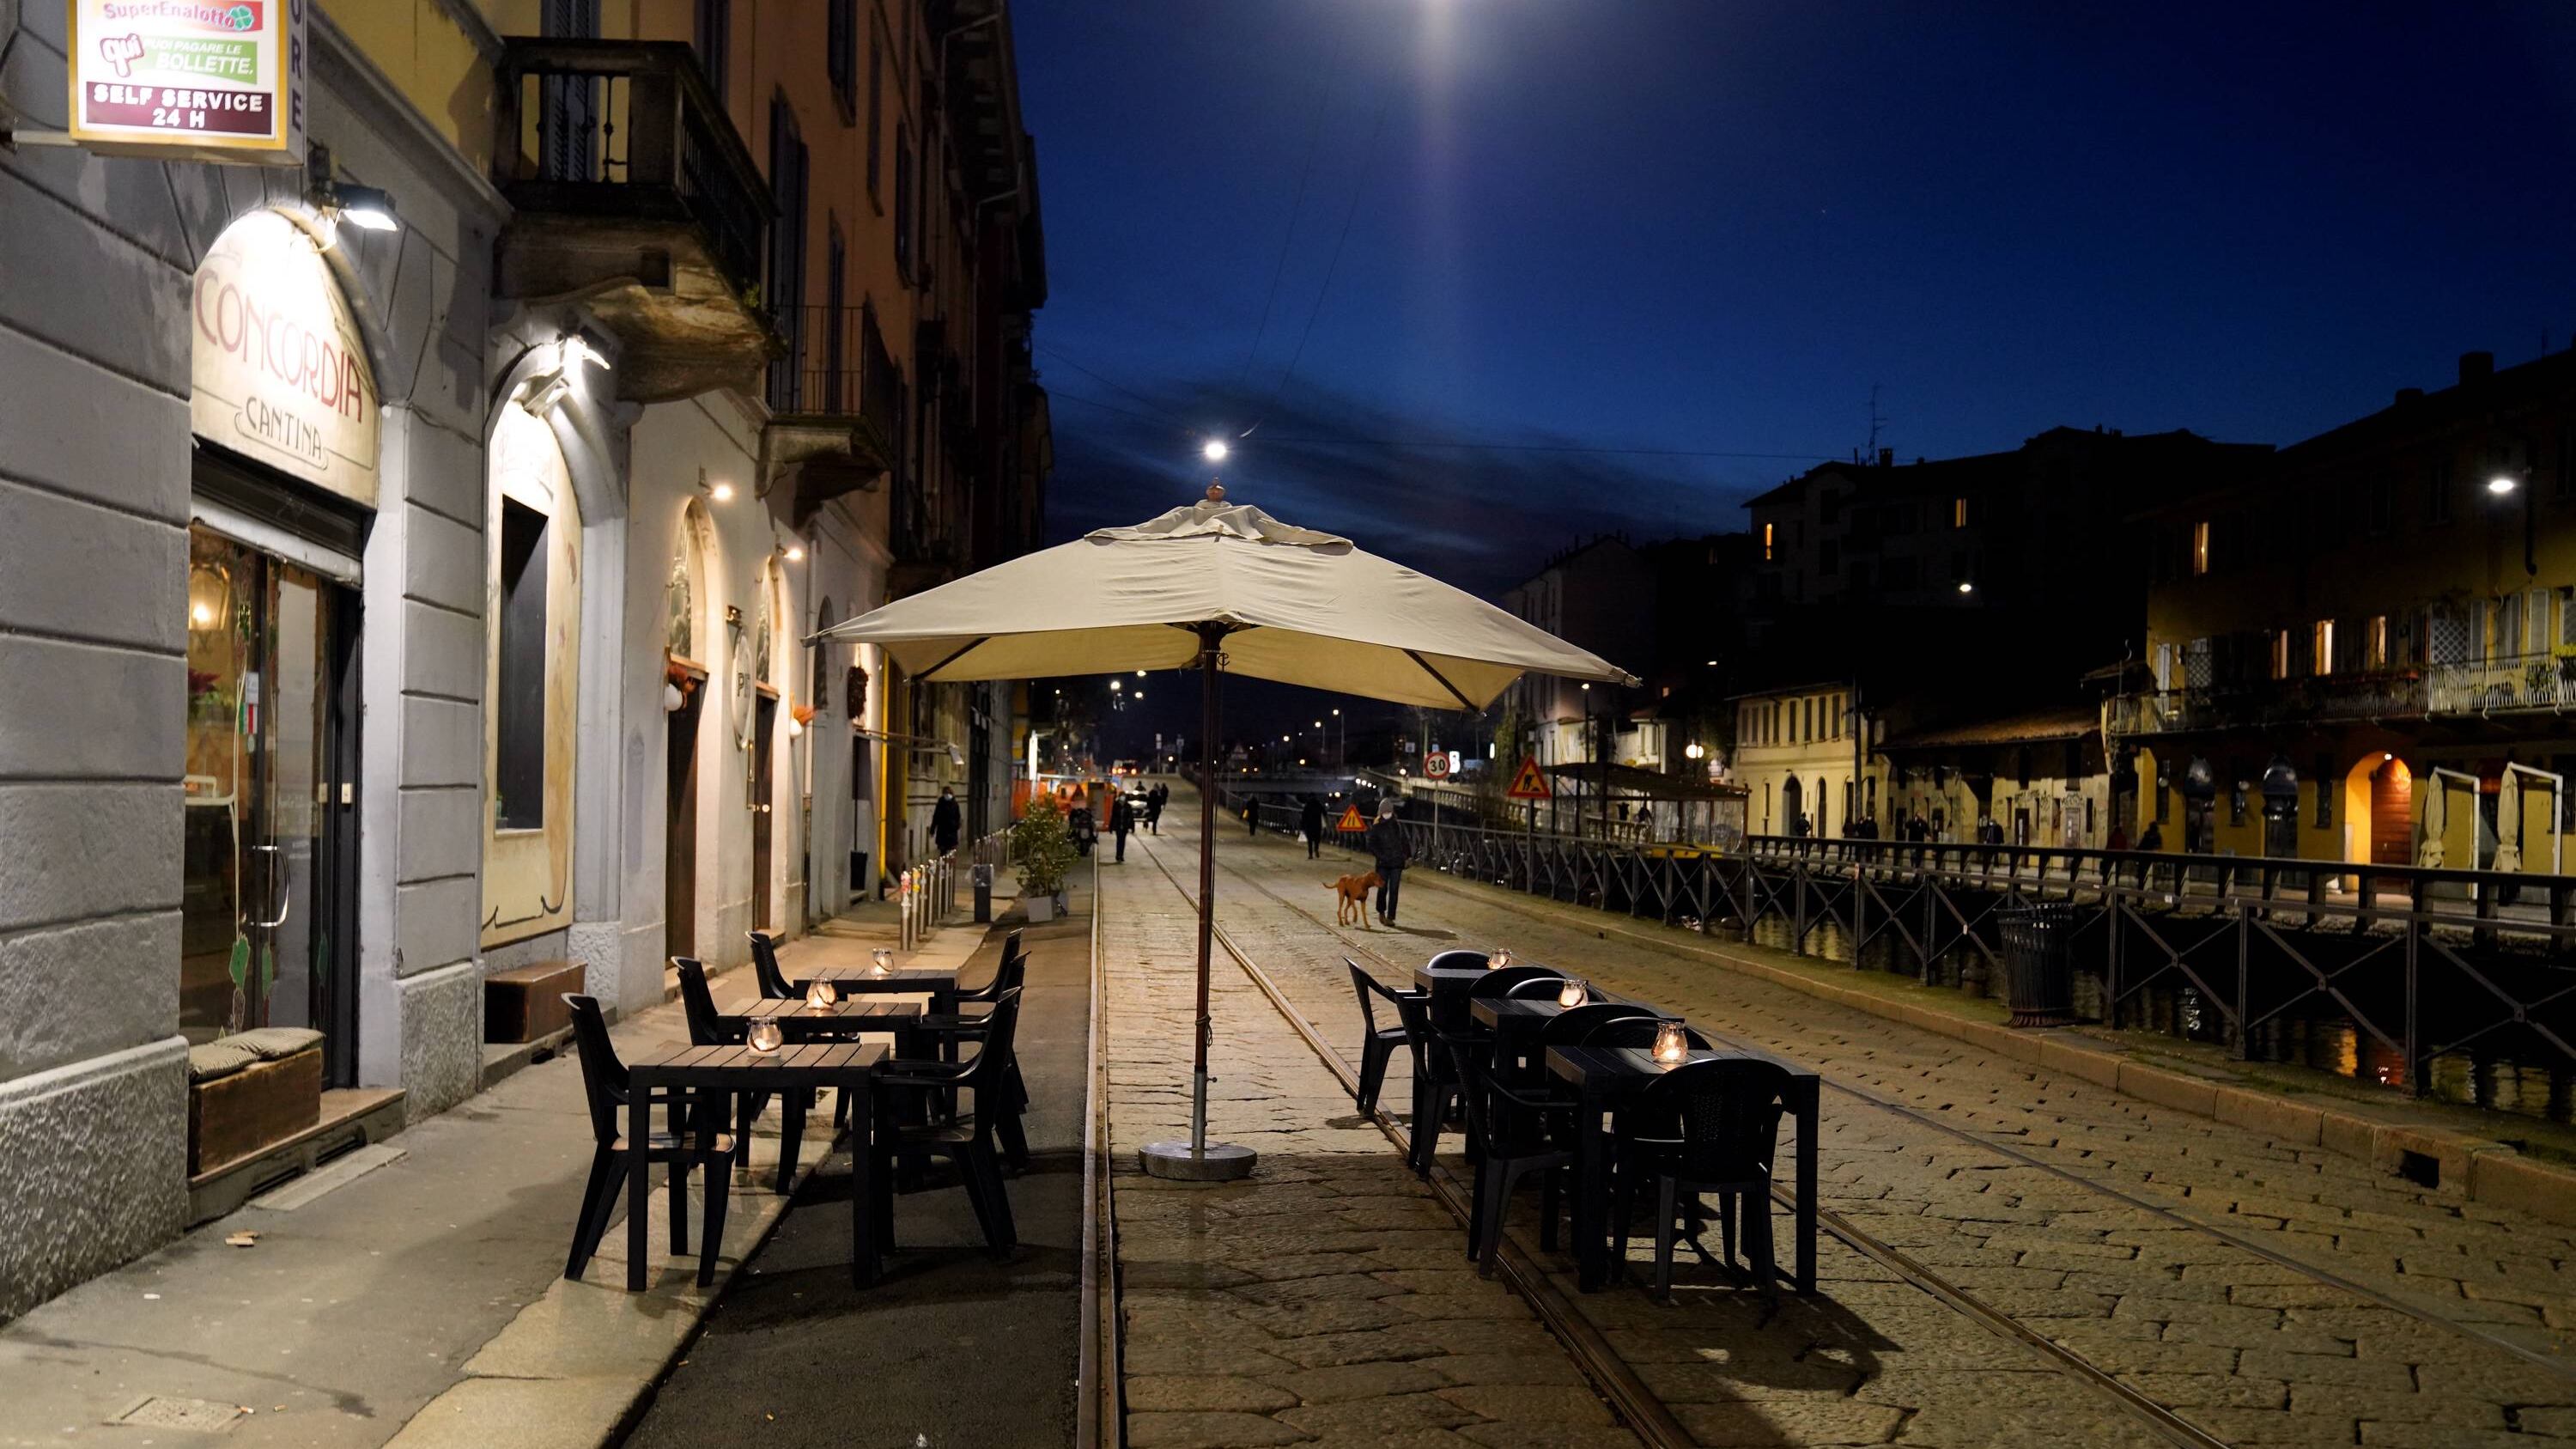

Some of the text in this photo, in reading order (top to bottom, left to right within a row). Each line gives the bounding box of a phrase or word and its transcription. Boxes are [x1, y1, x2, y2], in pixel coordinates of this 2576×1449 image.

[103, 1, 235, 28] SuperEnalotto
[173, 40, 225, 54] PAGARE
[226, 44, 242, 56] LE
[94, 84, 263, 113] SELF SERVICE
[152, 107, 205, 128] 24 H
[195, 268, 362, 423] CONCORDIA
[246, 396, 322, 460] CANTINA
[1430, 759, 1445, 772] 30
